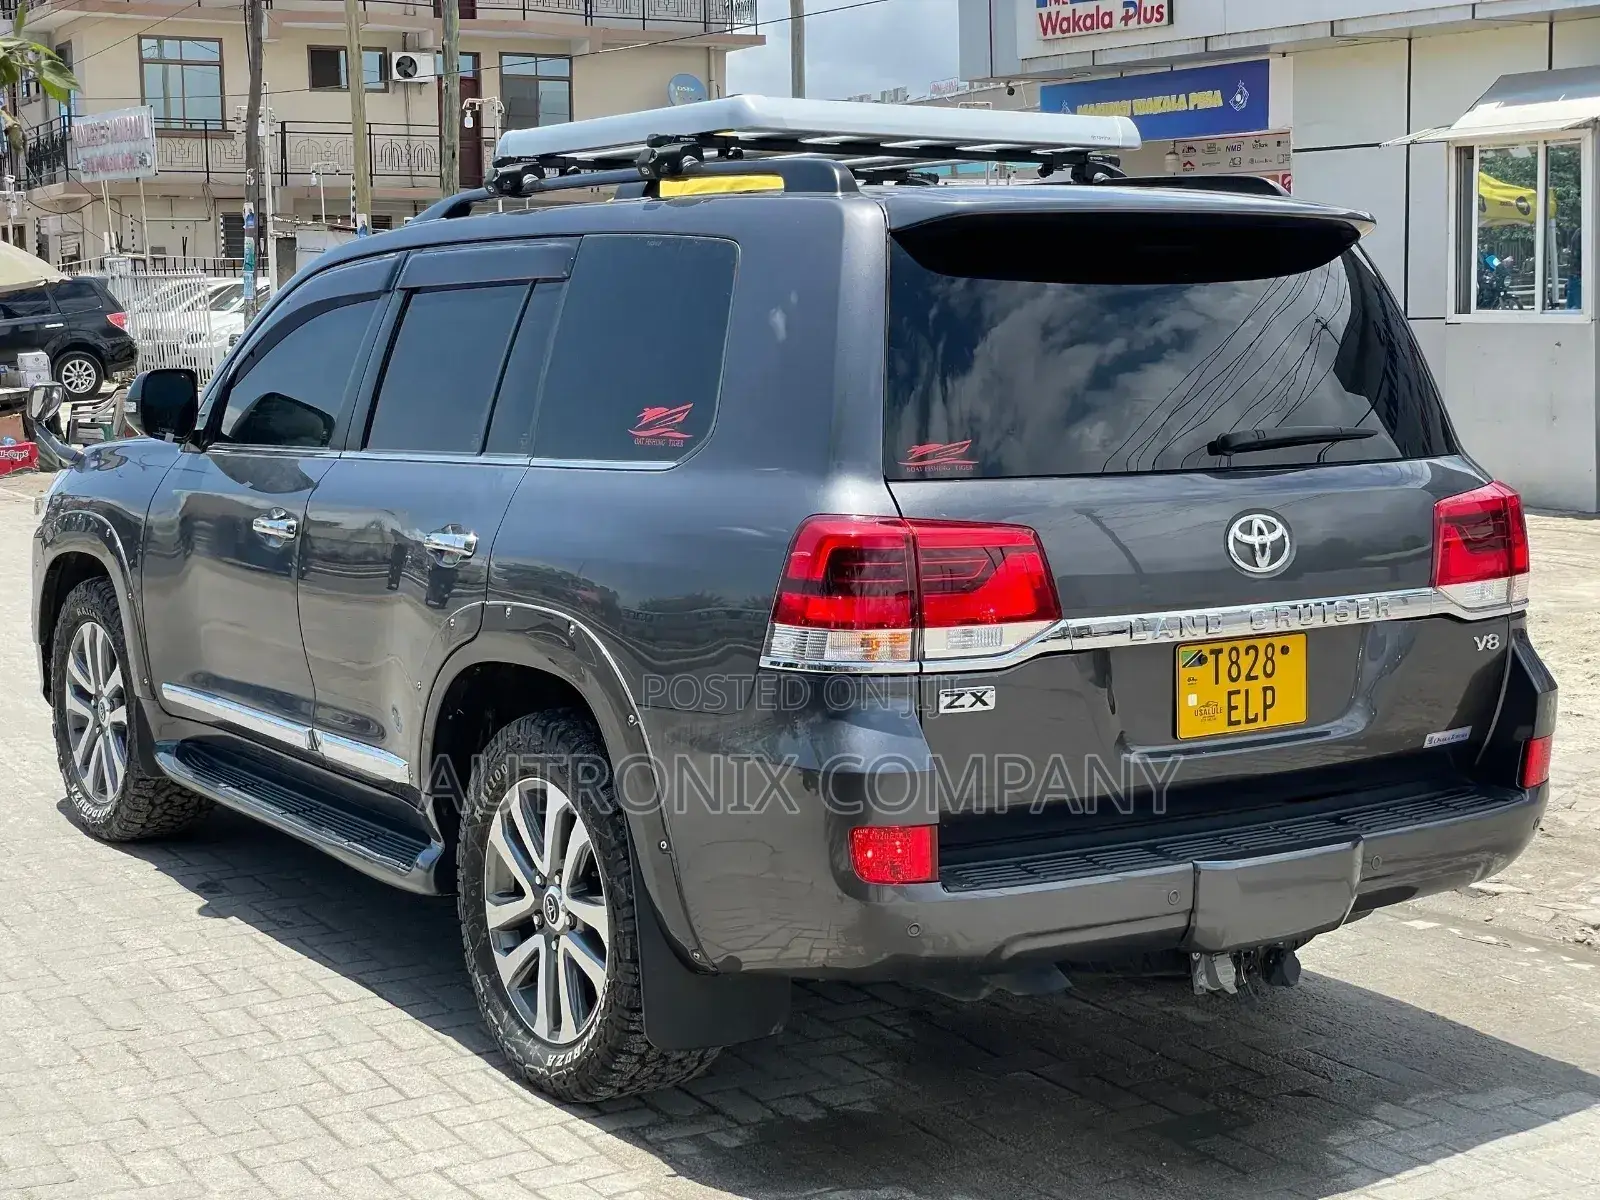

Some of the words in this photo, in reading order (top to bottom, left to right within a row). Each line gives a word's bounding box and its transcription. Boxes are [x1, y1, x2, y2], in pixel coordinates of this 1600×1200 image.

[1038, 5, 1113, 37] Wakala
[1119, 0, 1165, 27] Plus
[1188, 90, 1224, 111] PESA
[1226, 144, 1242, 153] NMB
[668, 439, 684, 447] TIGER
[1129, 613, 1224, 641] LAND
[1249, 597, 1392, 631] CRUISER
[1473, 633, 1500, 652] V8
[1209, 642, 1276, 685] T828
[943, 690, 991, 709] ZX
[1227, 685, 1276, 727] ELP
